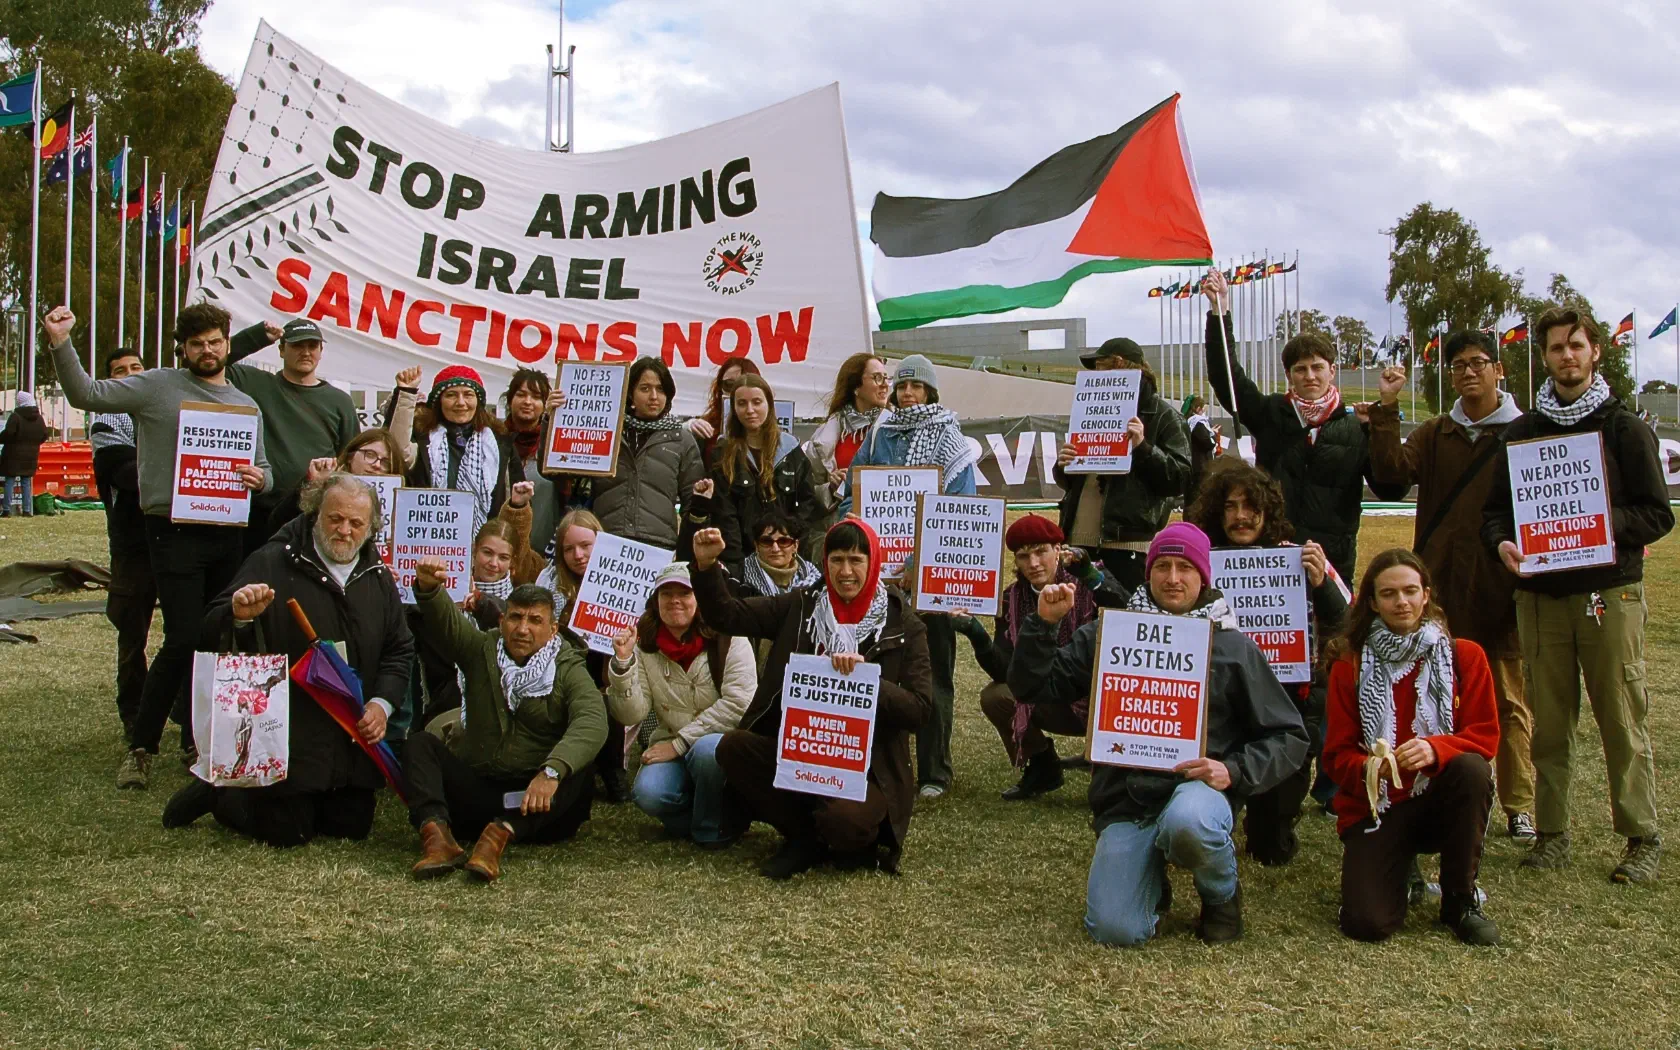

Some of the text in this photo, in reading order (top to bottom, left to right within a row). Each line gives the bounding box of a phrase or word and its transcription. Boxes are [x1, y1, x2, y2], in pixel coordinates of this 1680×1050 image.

[326, 126, 757, 239] STOP ARMING
[703, 232, 761, 273] STOP THE WAR
[417, 233, 639, 300] ISRAEL
[707, 252, 763, 295] ON PALESTINE
[270, 259, 813, 367] SANCTIONS NOW
[574, 369, 611, 381] NO F-35
[570, 383, 611, 397] FIGHTER
[1084, 378, 1129, 388] ALBANESE,
[1076, 391, 1135, 402] CUT TIES WITH
[563, 398, 612, 412] JET PARTS
[1085, 406, 1121, 415] ISRAEL'S
[562, 415, 609, 428] TO ISRAEL
[1081, 419, 1122, 429] GENOCIDE
[184, 426, 252, 440] RESISTANCE
[561, 429, 607, 441] SANCTIONS
[1077, 433, 1123, 443] SANCTIONS
[183, 438, 251, 451] IS JUSTIFIED
[570, 442, 594, 454] NOW!
[1087, 445, 1111, 455] NOW!
[1539, 444, 1568, 461] END
[200, 459, 231, 469] WHEN
[1521, 459, 1591, 483] WEAPONS
[186, 469, 242, 480] PALESTINE
[888, 475, 911, 486] END
[181, 478, 245, 491] IS OCCUPIED
[1517, 477, 1600, 502] EXPORTS TO
[418, 494, 451, 506] CLOSE
[870, 490, 928, 502] WEAPO
[190, 502, 231, 514] Solidarity
[865, 506, 916, 518] EXPORTS
[935, 502, 991, 517] ALBANESE,
[1536, 500, 1585, 520] ISRAEL
[409, 510, 458, 523] PINE GAP
[880, 523, 913, 534] ISRAE
[926, 518, 999, 533] CUT TIES WITH
[1530, 516, 1597, 536] SANCTIONS
[407, 526, 458, 540] SPY BASE
[879, 538, 914, 548] ANCTIO
[940, 536, 983, 549] ISRAEL'S
[1548, 535, 1582, 550] NOW!
[396, 545, 408, 555] NO
[411, 545, 466, 556] INTELLIGENCE
[620, 545, 645, 562] END
[398, 559, 417, 569] FOR
[934, 552, 986, 566] GENOCIDE
[1224, 556, 1290, 570] ALBANESE,
[599, 556, 657, 582] WEAPONS
[931, 568, 989, 581] SANCTIONS
[588, 570, 640, 596] EXPORTS
[944, 583, 973, 595] NOW!
[1215, 574, 1301, 590] CUT TIES WITH
[596, 591, 637, 613] ISRAEL
[1233, 594, 1285, 608] ISRAEL'S
[1237, 614, 1291, 628] ENOCIDE
[1136, 623, 1172, 644] BAE
[1110, 646, 1194, 672] SYSTEMS
[791, 672, 874, 696] RESISTANCE
[1104, 676, 1197, 699] STOP ARMING
[789, 686, 873, 709] IS JUSTIFIED
[1120, 697, 1178, 717] ISRAEL'S
[808, 715, 846, 732] WHEN
[1113, 715, 1182, 736] GENOCIDE
[791, 726, 860, 748] PALESTINE
[785, 738, 864, 761] IS OCCUPIED
[1140, 751, 1177, 760] PALESTINE
[795, 770, 844, 789] Solidarity
